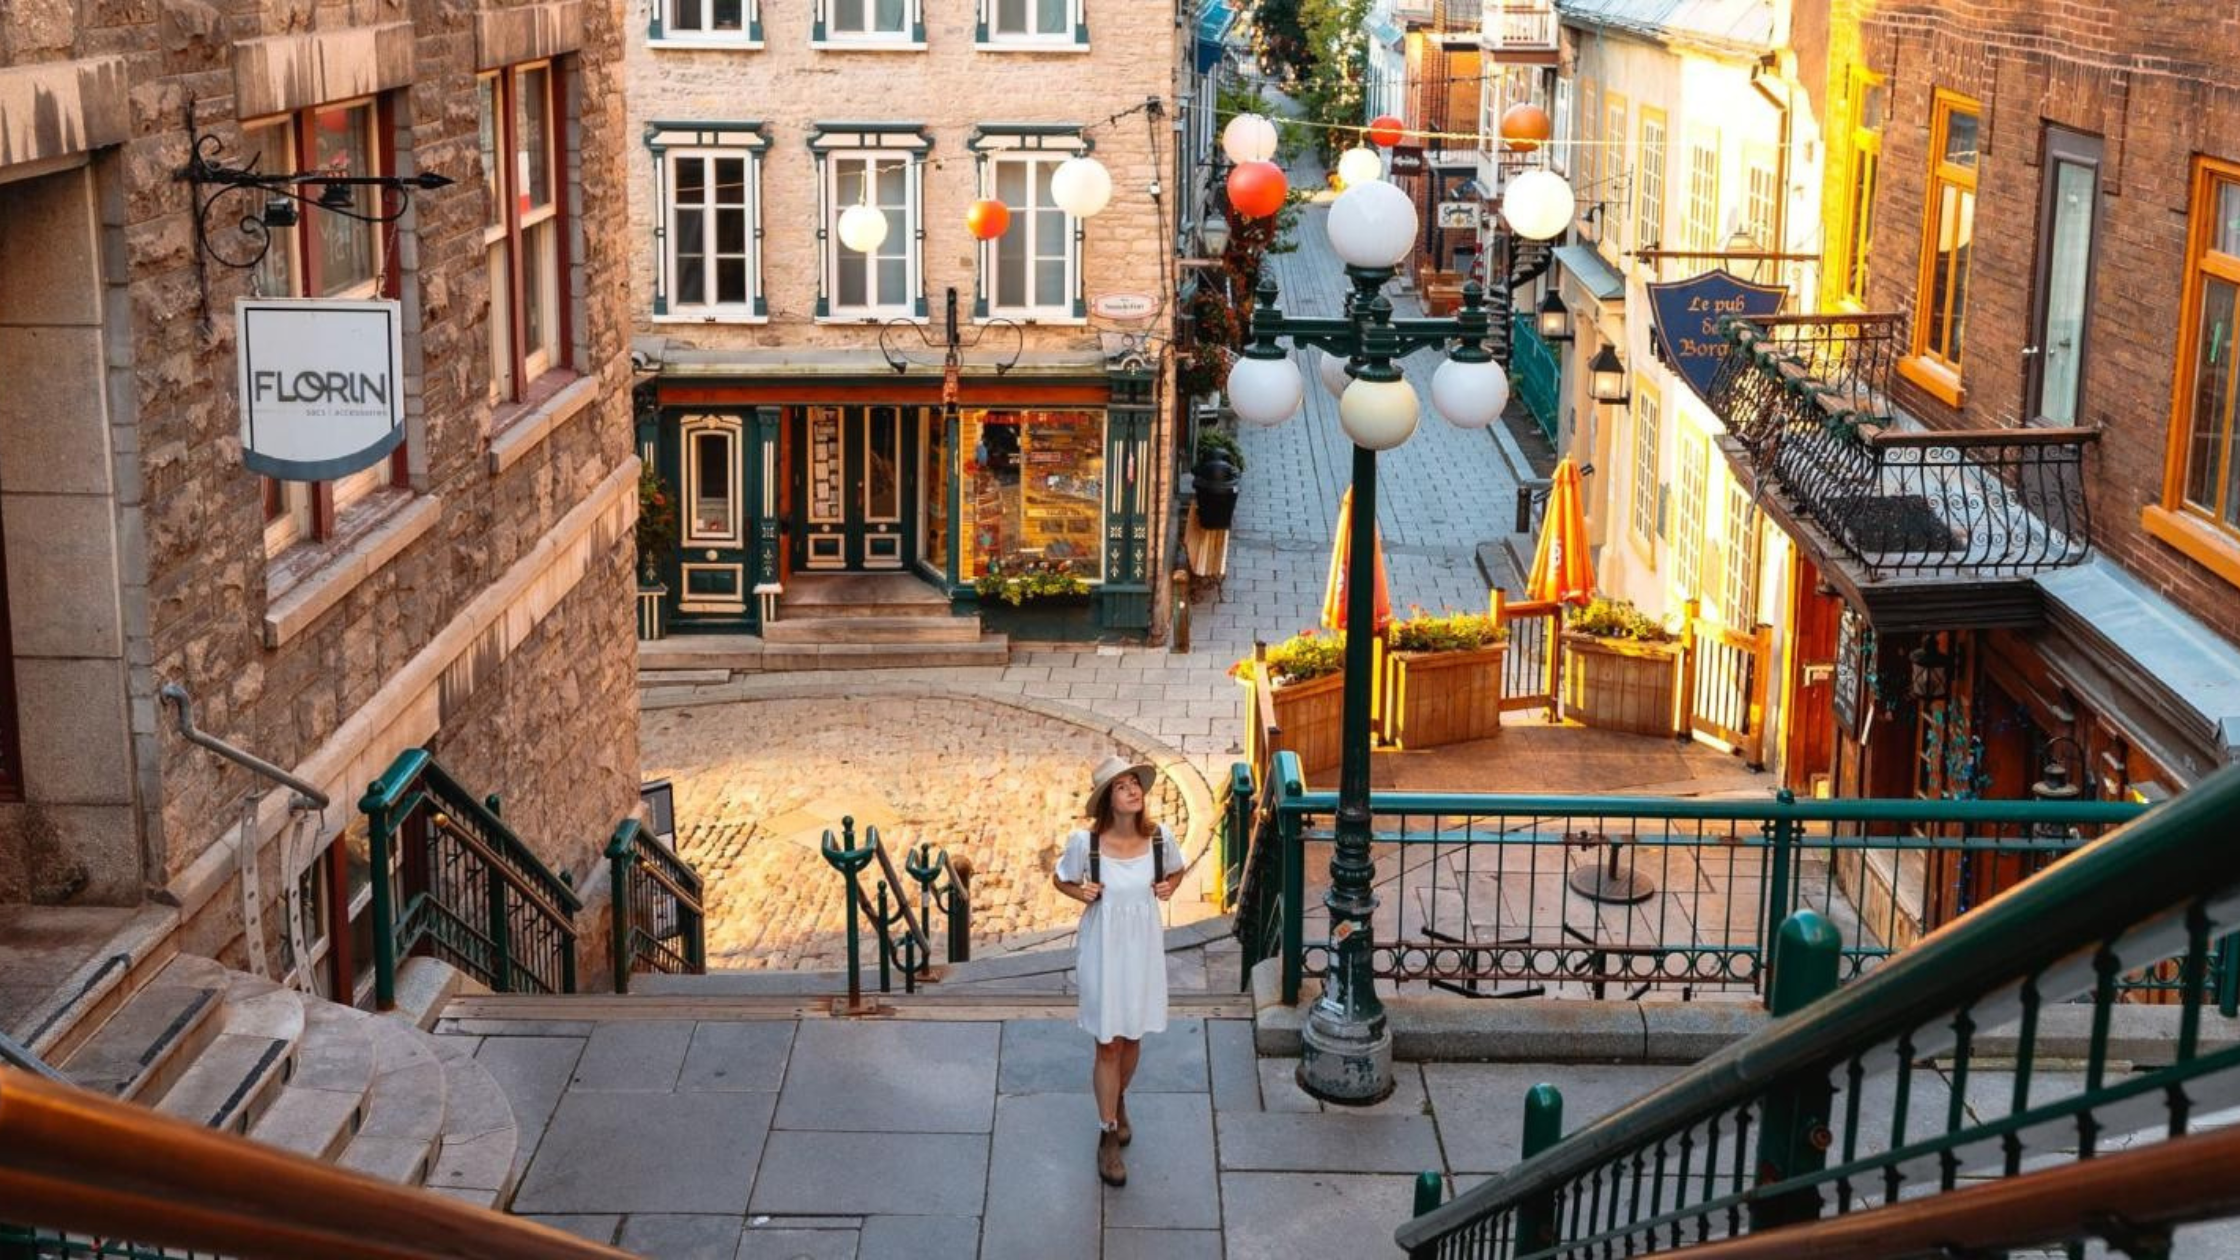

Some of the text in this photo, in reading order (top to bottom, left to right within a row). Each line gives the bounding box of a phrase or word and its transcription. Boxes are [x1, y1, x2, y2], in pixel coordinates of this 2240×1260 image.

[1687, 294, 1745, 313] Le pub
[1679, 338, 1731, 362] Borg
[254, 370, 387, 404] FLORIN
